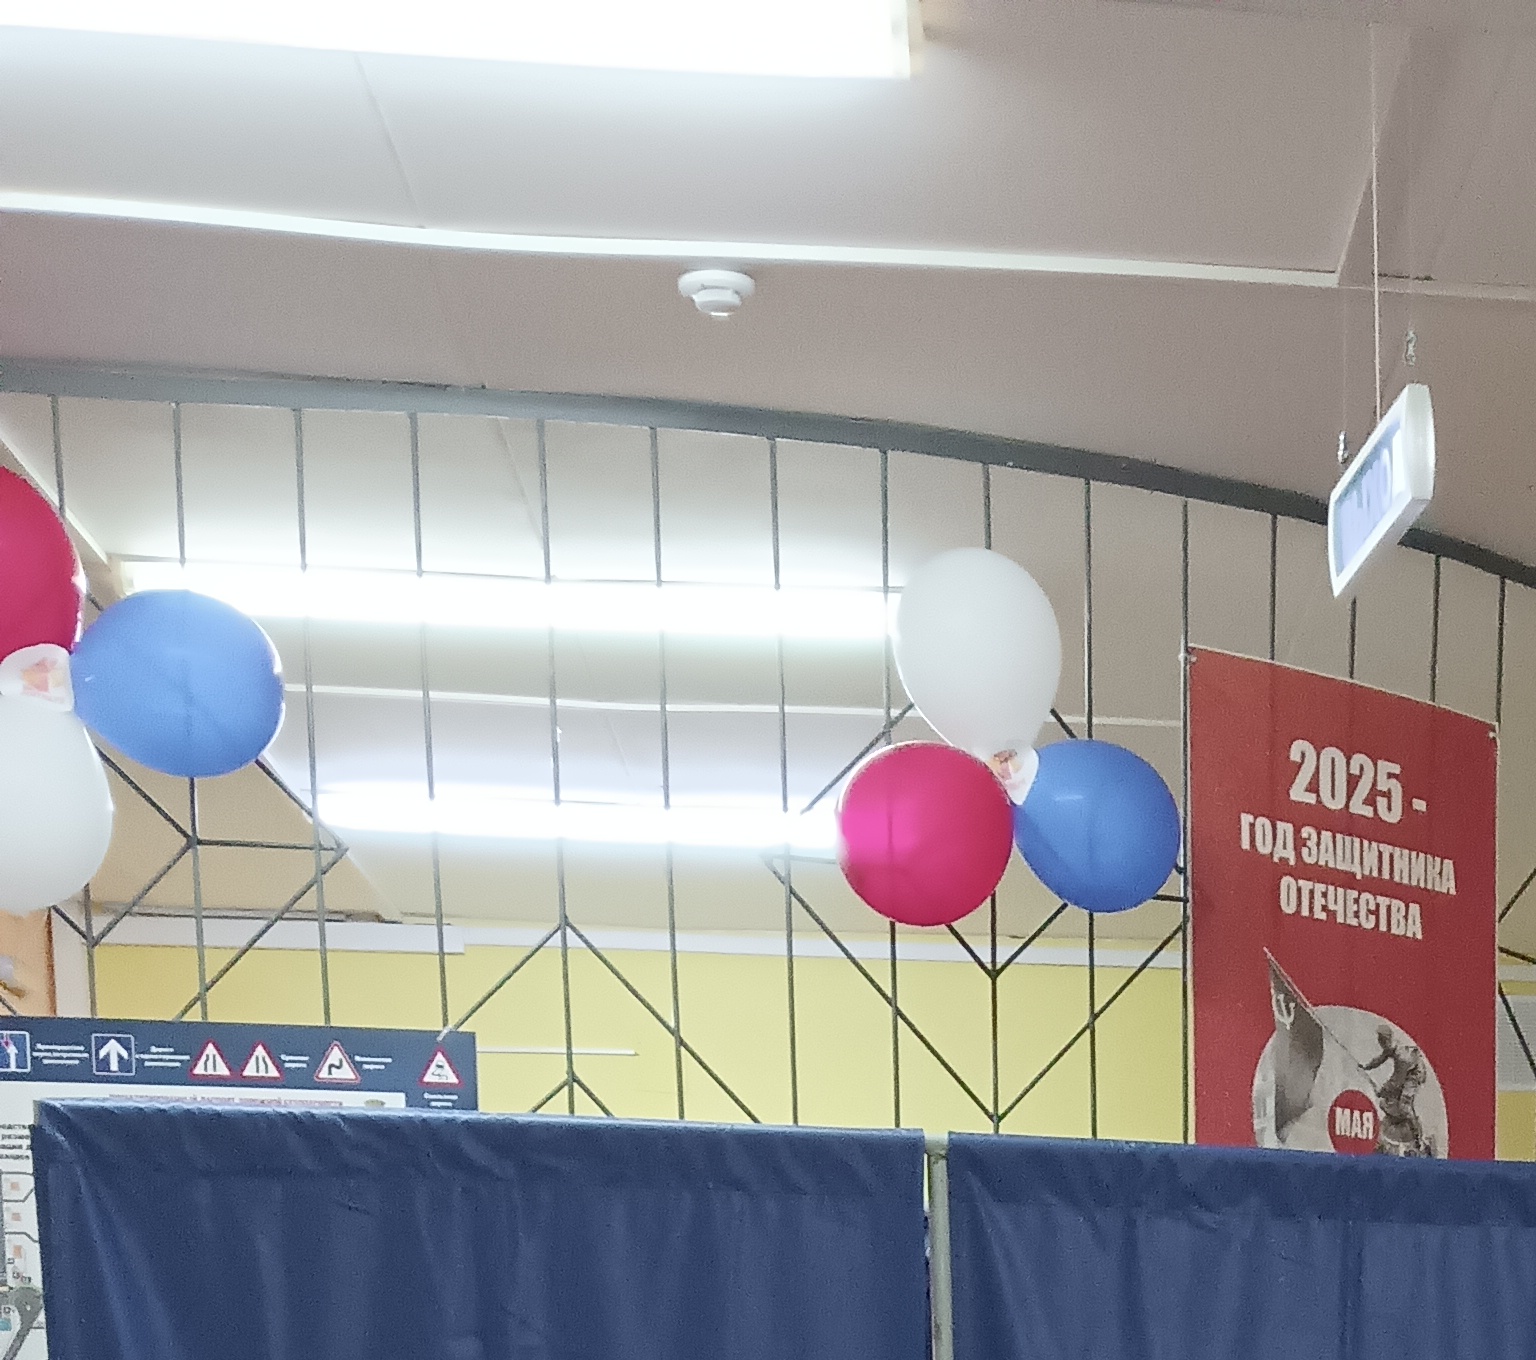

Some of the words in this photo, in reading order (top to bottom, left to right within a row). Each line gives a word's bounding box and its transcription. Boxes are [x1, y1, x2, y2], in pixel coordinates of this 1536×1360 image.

[1289, 739, 1402, 824] 2025
[1240, 812, 1296, 866] ГОД
[1301, 825, 1457, 896] ЗАЩИТНИКА
[1279, 875, 1424, 941] ОТЕЧЕСТВА
[1334, 1106, 1375, 1142] МАЯ
